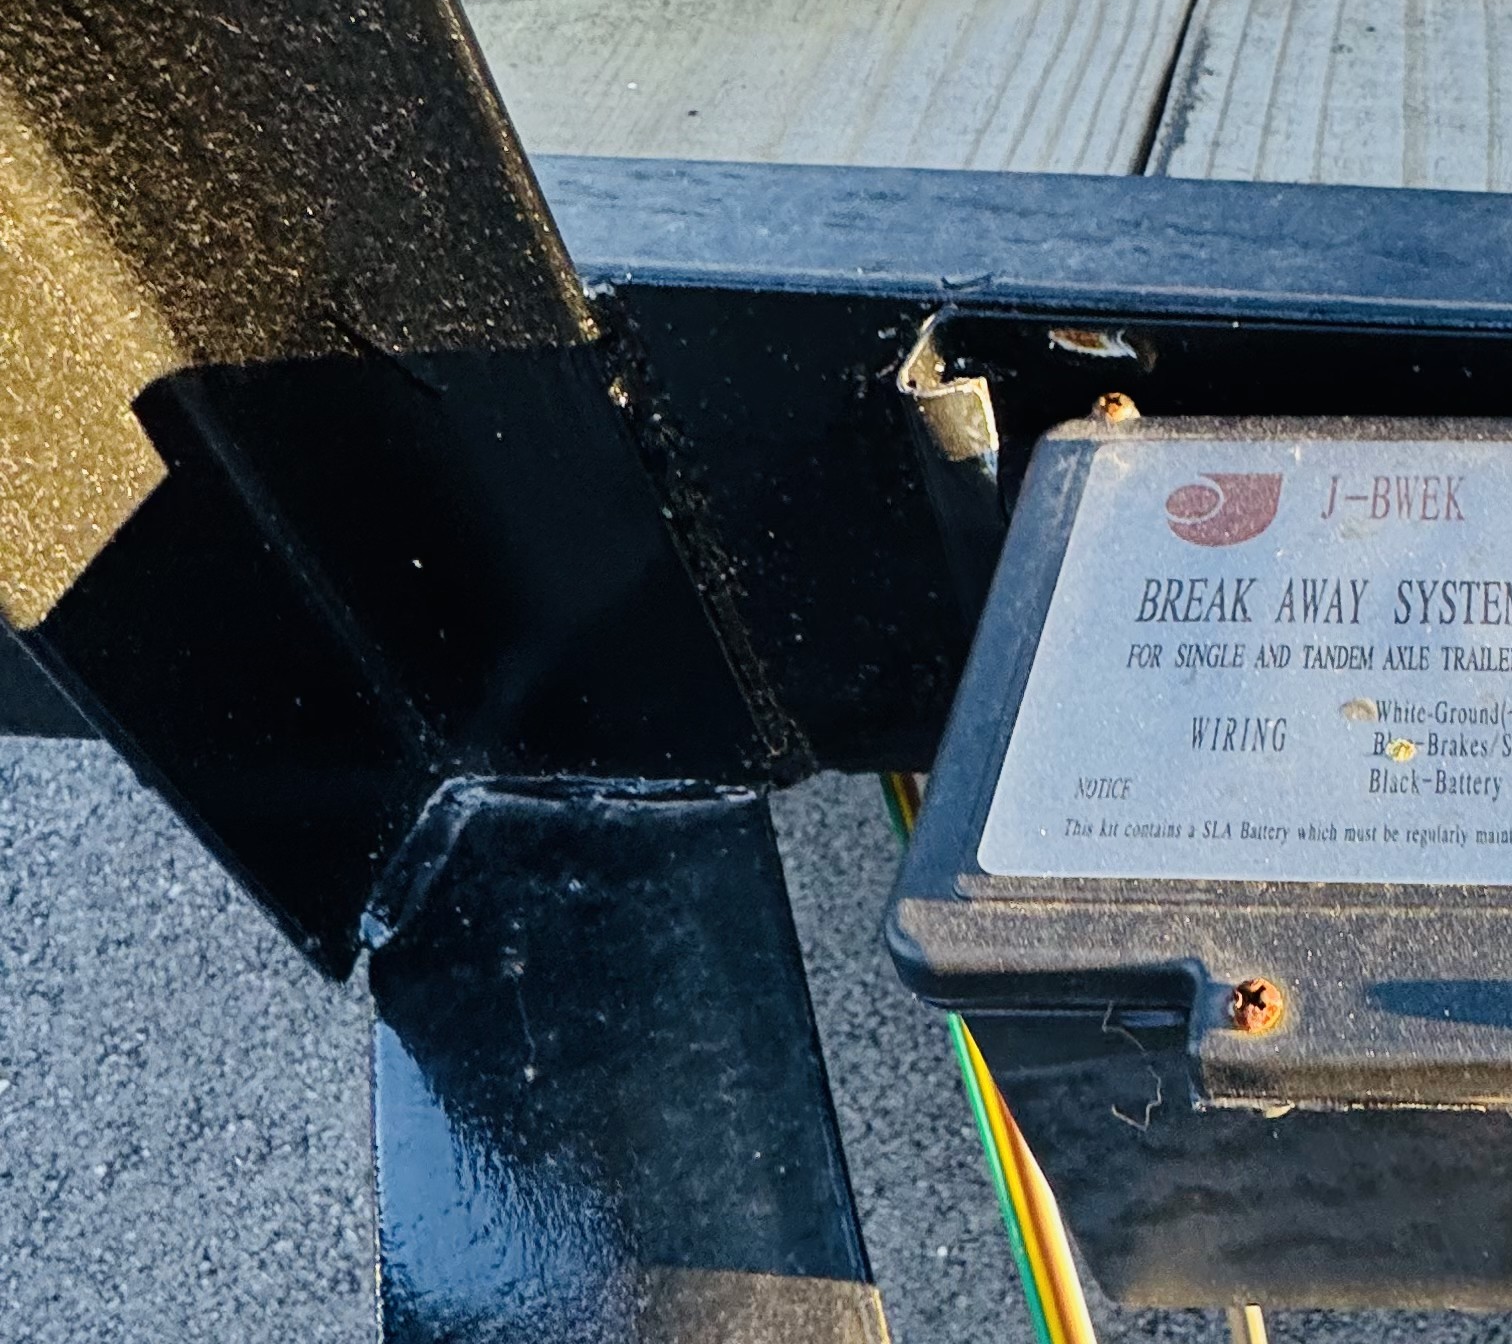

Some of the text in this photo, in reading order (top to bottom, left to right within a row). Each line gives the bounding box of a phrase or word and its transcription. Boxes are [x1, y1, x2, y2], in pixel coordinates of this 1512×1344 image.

[1320, 474, 1466, 522] J-BWEK
[1134, 576, 1258, 624] BREAK
[1274, 576, 1370, 625] AWAY
[1126, 642, 1164, 669] FOR
[1173, 643, 1246, 669] SINGLE
[1254, 643, 1292, 670] AND
[1301, 644, 1375, 671] TANDEM
[1382, 645, 1431, 671] AXLE
[1190, 716, 1288, 753] WIRING
[1074, 776, 1132, 800] NOTICE
[1368, 767, 1502, 802] Black-Battery
[1065, 818, 1093, 838] This
[1099, 818, 1119, 838] kit
[1124, 819, 1183, 839] contains
[1202, 820, 1232, 840] SLA
[1240, 820, 1290, 847] Battery
[1298, 822, 1338, 842] which
[1343, 823, 1377, 844] must
[1383, 823, 1400, 844] be
[1405, 823, 1468, 848] regularly
